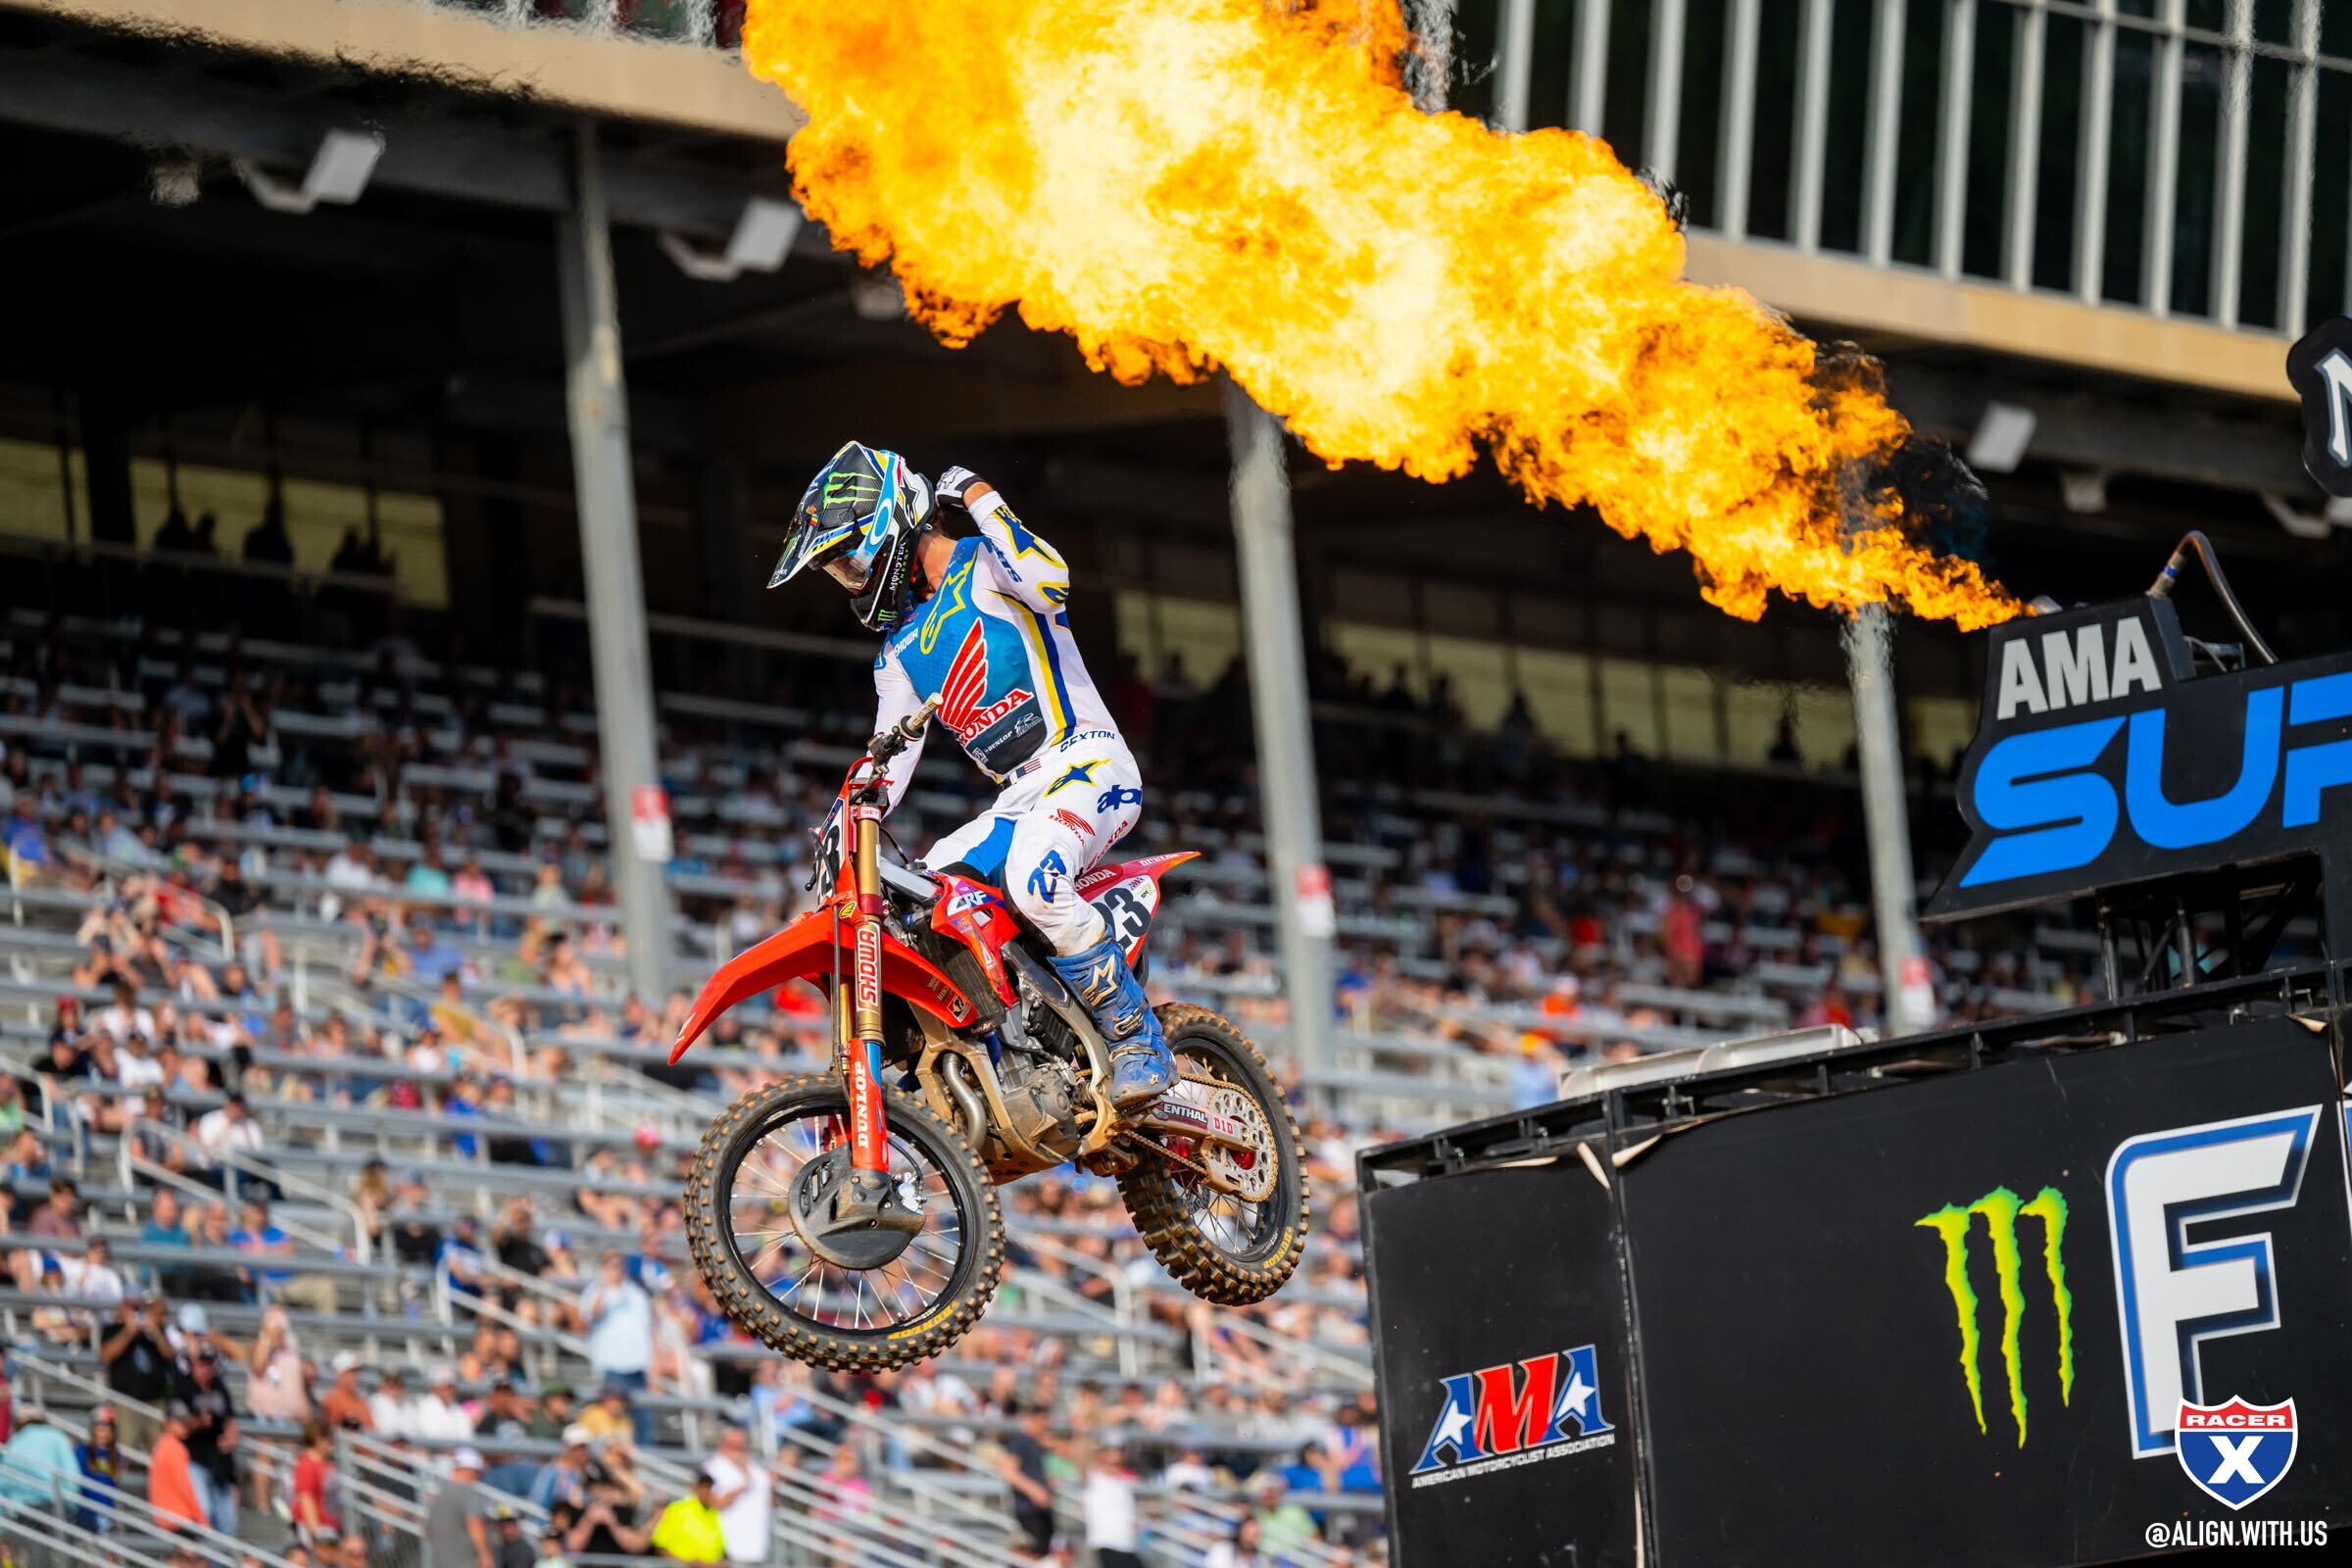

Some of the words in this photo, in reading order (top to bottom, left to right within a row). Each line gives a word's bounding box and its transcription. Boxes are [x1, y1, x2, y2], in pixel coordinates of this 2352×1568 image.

[889, 542, 906, 591] MONSTER
[893, 627, 919, 657] SHOWA
[1997, 615, 2162, 720] AMA
[987, 730, 1013, 752] DUNLOP
[858, 928, 879, 1008] SHOWA
[857, 1061, 868, 1149] DUNLOP
[1163, 1102, 1207, 1123] ENTHAL
[1213, 1117, 1234, 1135] DID
[1263, 1231, 1294, 1270] DUNLOP
[2105, 1103, 2352, 1460] F
[1408, 1344, 1615, 1475] AMA
[1411, 1469, 1466, 1489] AMERICAN
[1466, 1451, 1545, 1477] MOTORCYCLIST
[1545, 1433, 1616, 1459] ASSOCIATION
